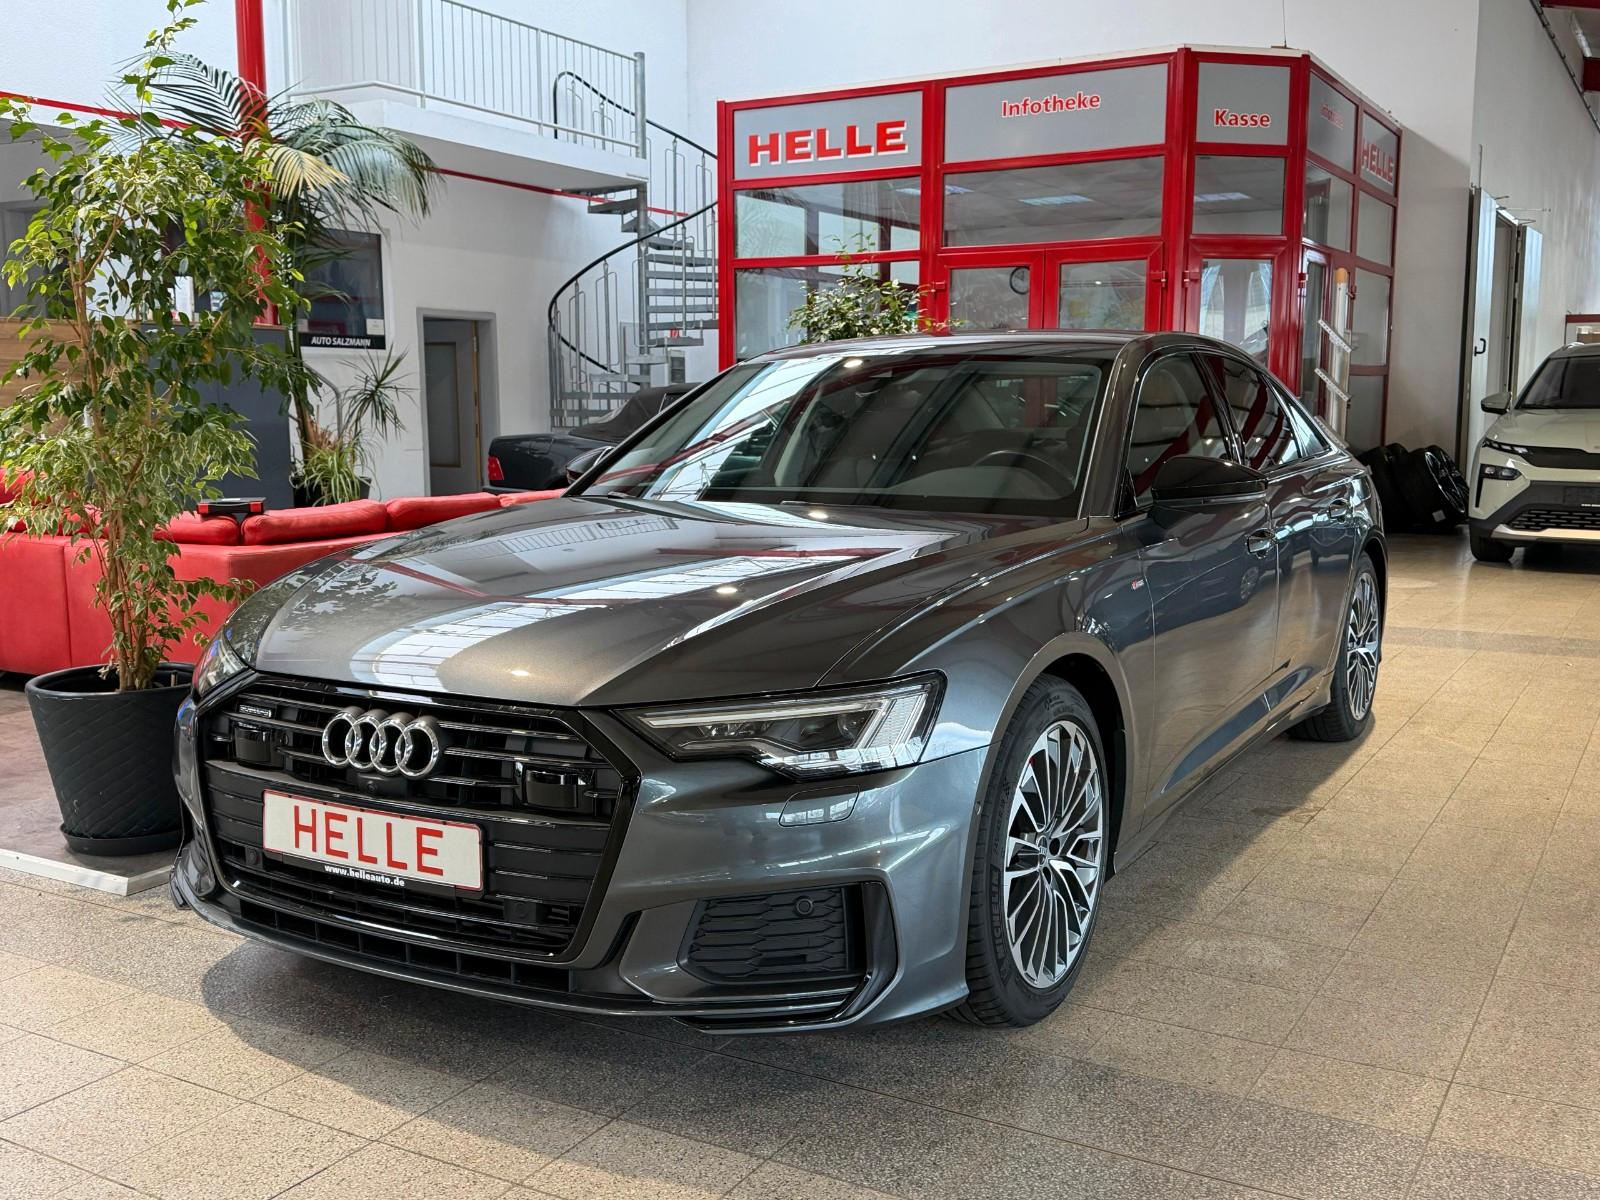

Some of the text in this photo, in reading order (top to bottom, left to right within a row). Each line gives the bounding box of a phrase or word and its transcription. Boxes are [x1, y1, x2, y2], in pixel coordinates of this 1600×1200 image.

[1001, 90, 1101, 118] Infotheke
[1213, 108, 1271, 127] Kasse
[748, 120, 908, 167] HELLE
[1361, 138, 1394, 186] HELLE
[311, 336, 371, 346] AUTO SALZMANN
[294, 805, 444, 876] HELLE
[324, 864, 405, 887] www.helleauto.de
[991, 868, 1006, 960] MICHELIN
